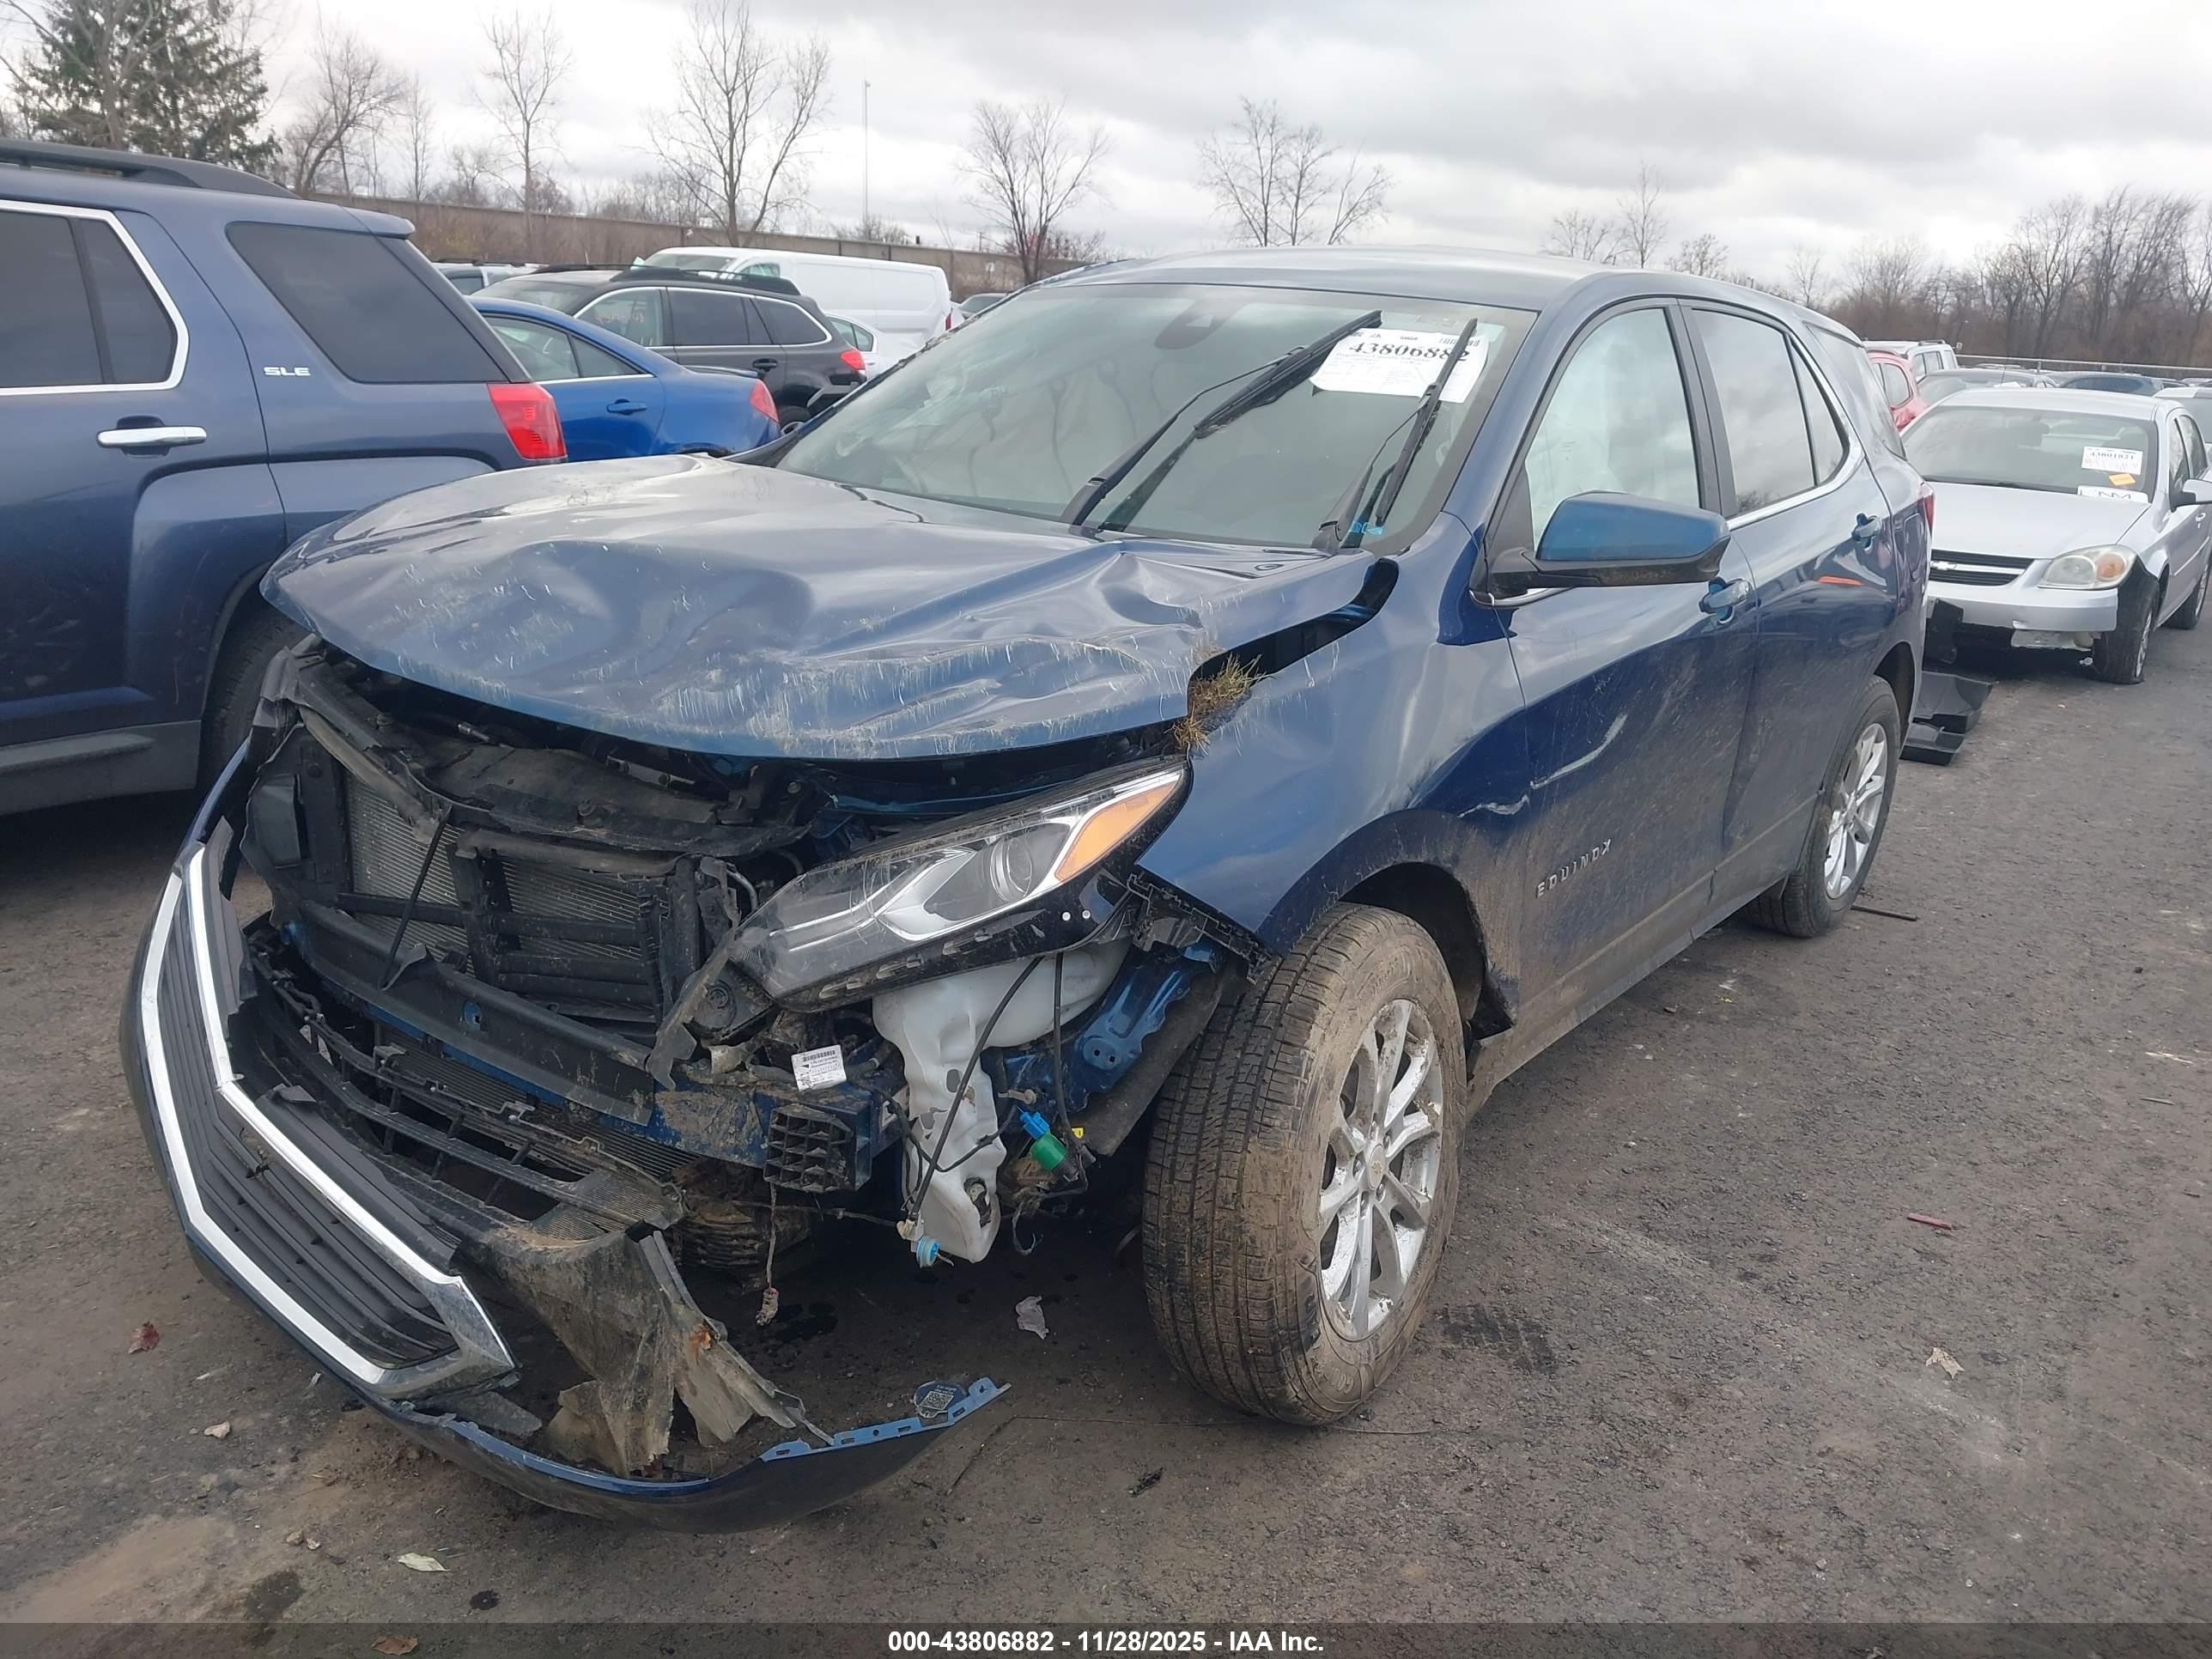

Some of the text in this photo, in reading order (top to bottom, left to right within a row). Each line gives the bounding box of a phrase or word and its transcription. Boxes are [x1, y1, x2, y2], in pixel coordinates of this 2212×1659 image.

[1348, 342, 1471, 362] 43806882
[264, 367, 311, 376] SLE
[1536, 838, 1612, 897] EQUINOX
